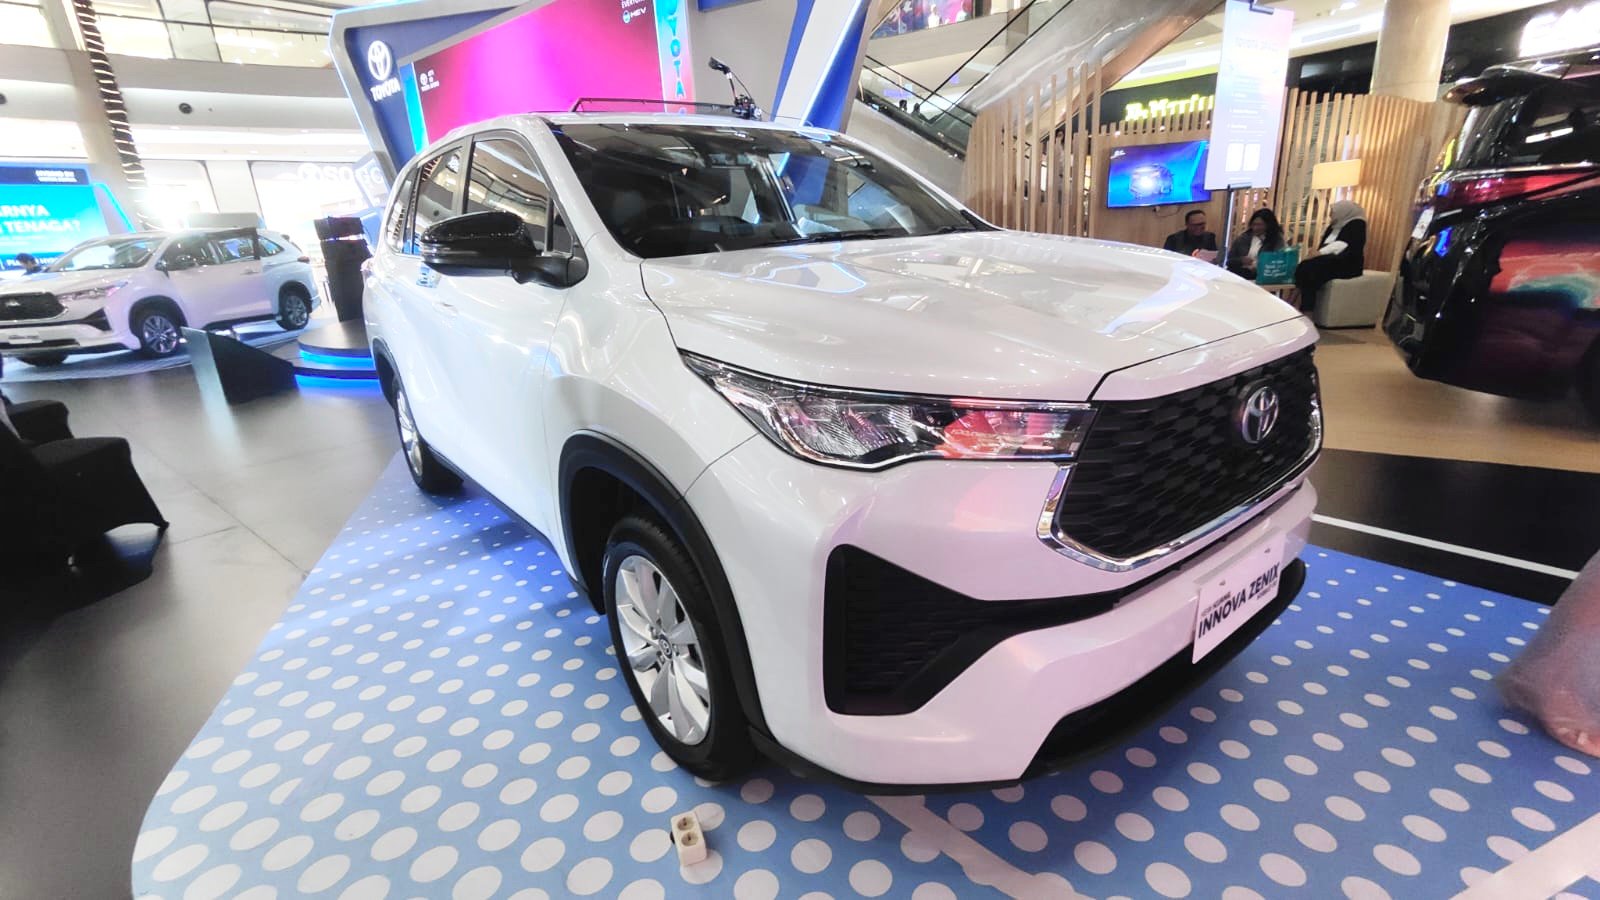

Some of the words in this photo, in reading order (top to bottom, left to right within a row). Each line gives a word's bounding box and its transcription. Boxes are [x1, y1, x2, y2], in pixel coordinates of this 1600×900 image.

[370, 77, 401, 102] TOYOTA
[1198, 588, 1247, 639] INNOVA
[1247, 562, 1280, 600] ZENIX
